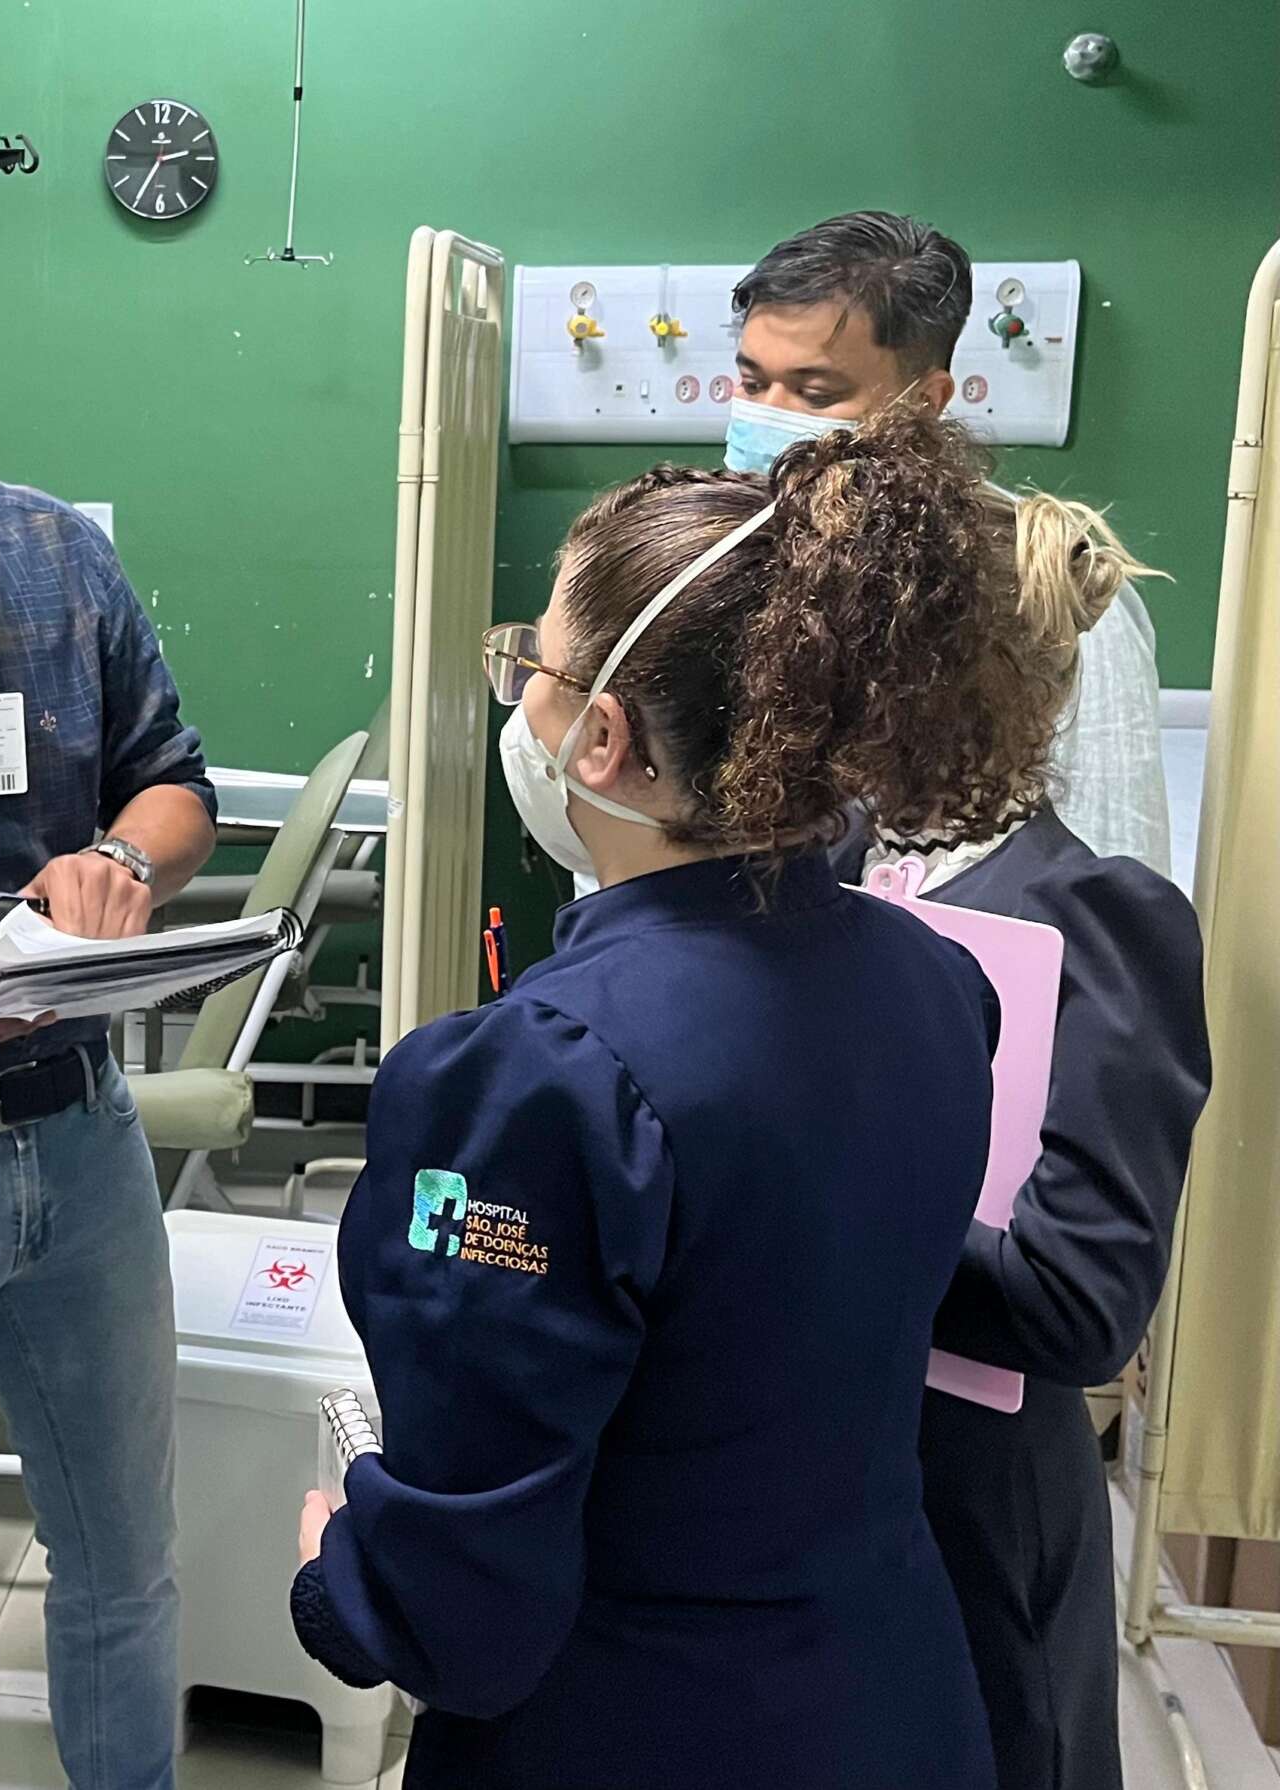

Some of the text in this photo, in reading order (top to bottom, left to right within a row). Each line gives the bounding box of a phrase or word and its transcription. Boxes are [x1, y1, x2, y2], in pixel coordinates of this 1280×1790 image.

[153, 103, 171, 124] 12
[155, 193, 166, 213] 6
[467, 1199, 530, 1224] HOSPITAL
[490, 1222, 526, 1241] JOSÉ
[464, 1231, 549, 1259] DE DOENÇAS
[460, 1247, 549, 1275] INFECCIOSAS
[245, 1301, 307, 1312] INFECTANTE
